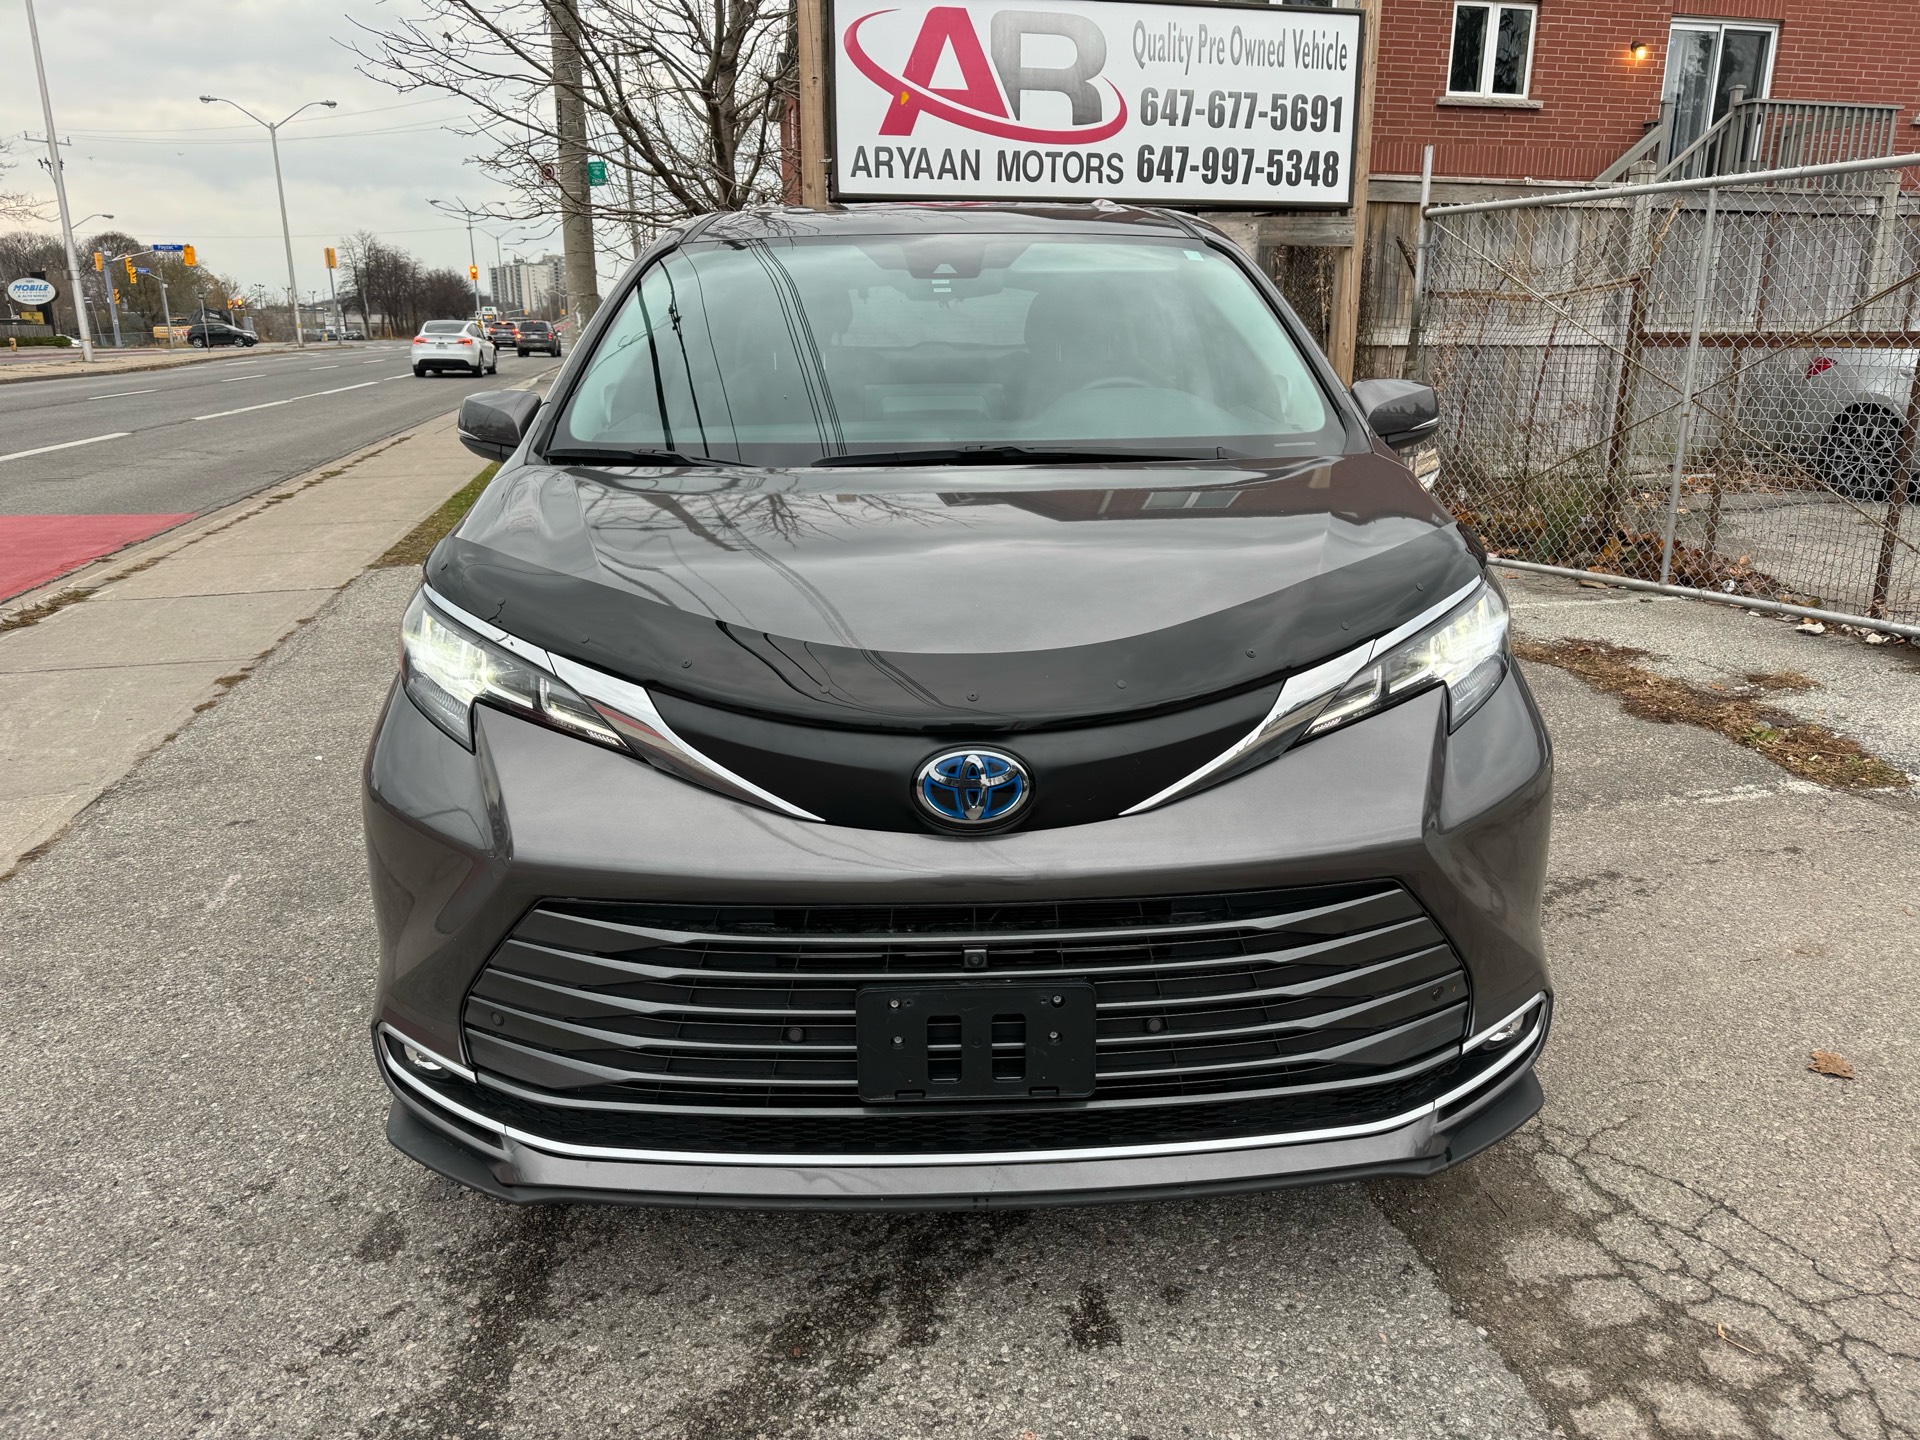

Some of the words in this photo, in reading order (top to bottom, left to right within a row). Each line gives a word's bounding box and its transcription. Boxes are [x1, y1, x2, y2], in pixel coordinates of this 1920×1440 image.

[1132, 20, 1194, 75] Quality
[1198, 24, 1225, 65] Pre
[1230, 25, 1286, 68] Owned
[1292, 28, 1348, 71] Vehicle
[878, 6, 1107, 136] AR
[1140, 87, 1343, 133] 647-677-5691
[850, 146, 980, 181] ARYAAN
[997, 150, 1124, 185] MOTORS
[1137, 144, 1340, 188] 647-997-5348
